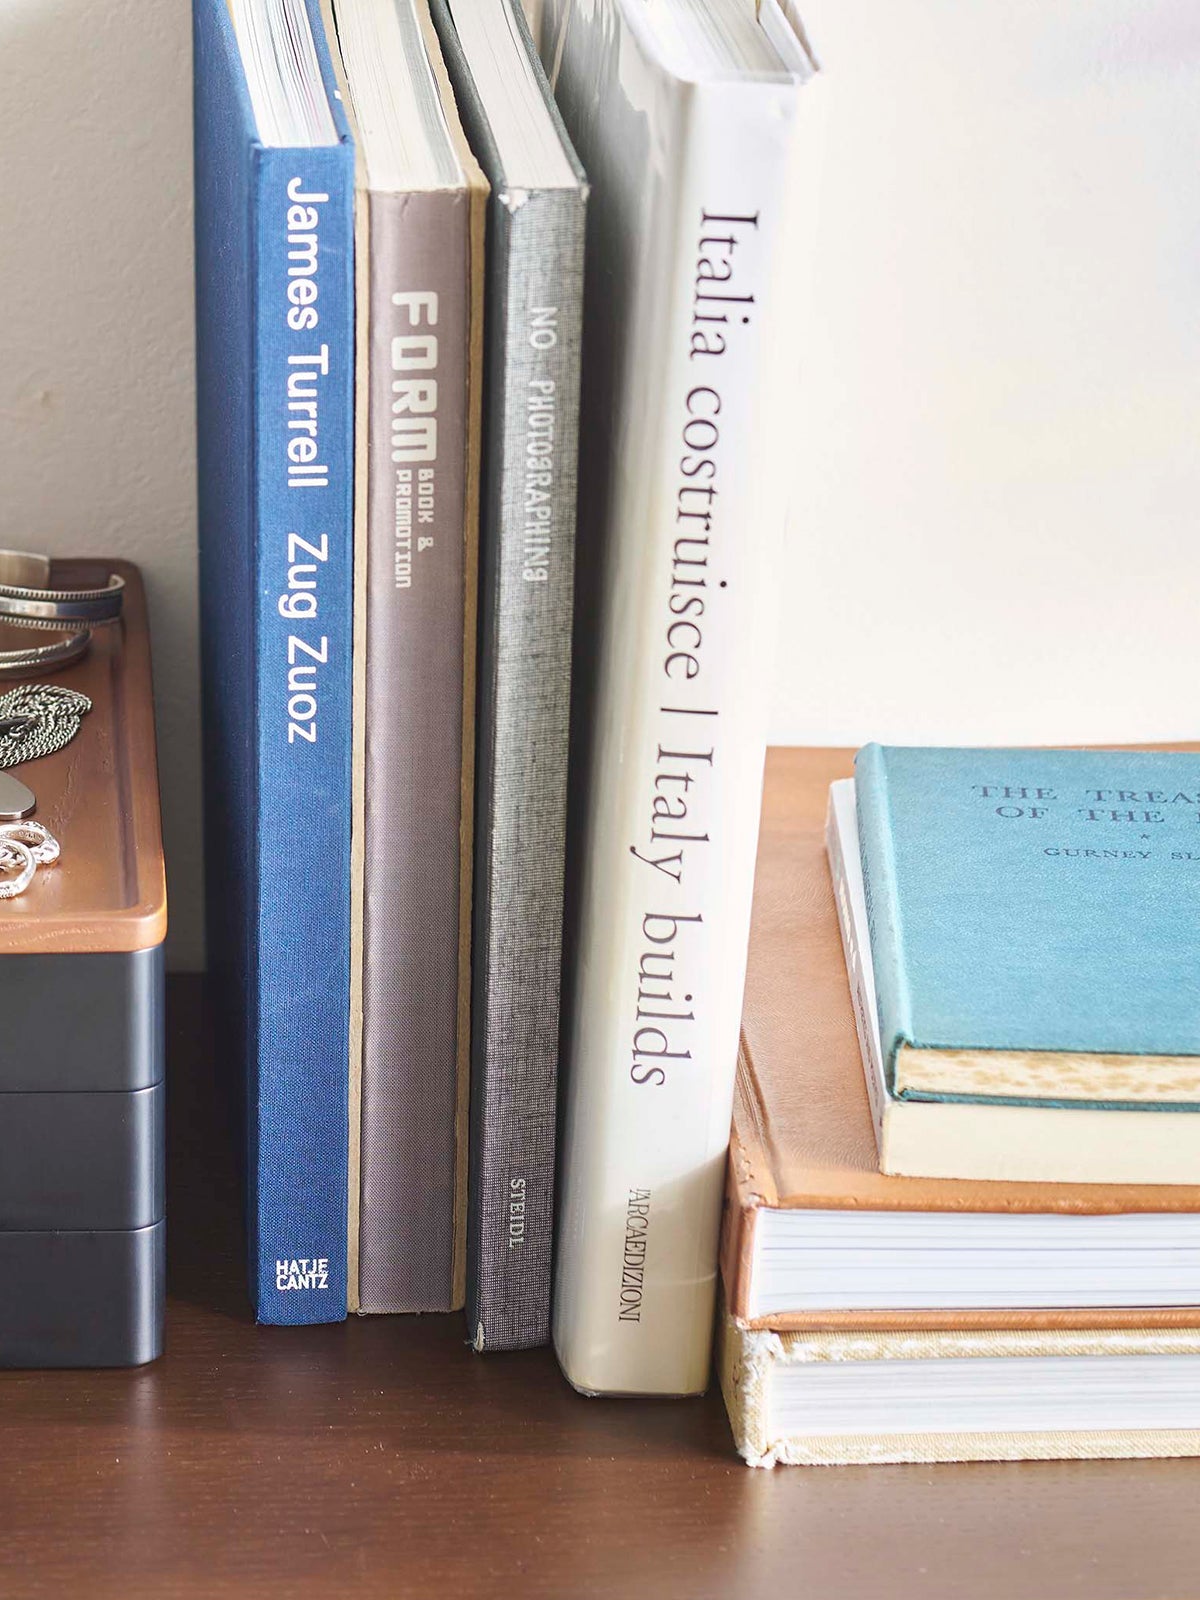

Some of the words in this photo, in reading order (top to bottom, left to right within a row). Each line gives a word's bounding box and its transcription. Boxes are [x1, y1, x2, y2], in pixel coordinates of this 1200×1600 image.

[286, 176, 330, 331] James
[688, 206, 760, 361] Italia
[390, 290, 439, 463] FORM
[528, 305, 559, 351] NO
[286, 343, 330, 487] Turrell
[394, 469, 412, 589] PROMOTION
[417, 467, 435, 524] BOOK
[522, 379, 557, 583] PHOTOGRAPHING
[277, 532, 329, 619] Zug
[417, 536, 435, 553] &
[663, 385, 728, 681] costruisce
[287, 635, 329, 744] Zuoz
[629, 742, 715, 885] Italy
[971, 784, 1058, 801] THE
[1085, 789, 1200, 804] TREA
[995, 805, 1049, 820] OF
[1077, 808, 1165, 823] THE
[1043, 847, 1153, 860] GURNEY
[630, 911, 704, 1088] builds
[508, 1178, 527, 1250] STEIDL
[275, 1258, 330, 1275] HATJE
[275, 1273, 330, 1291] CANTZ
